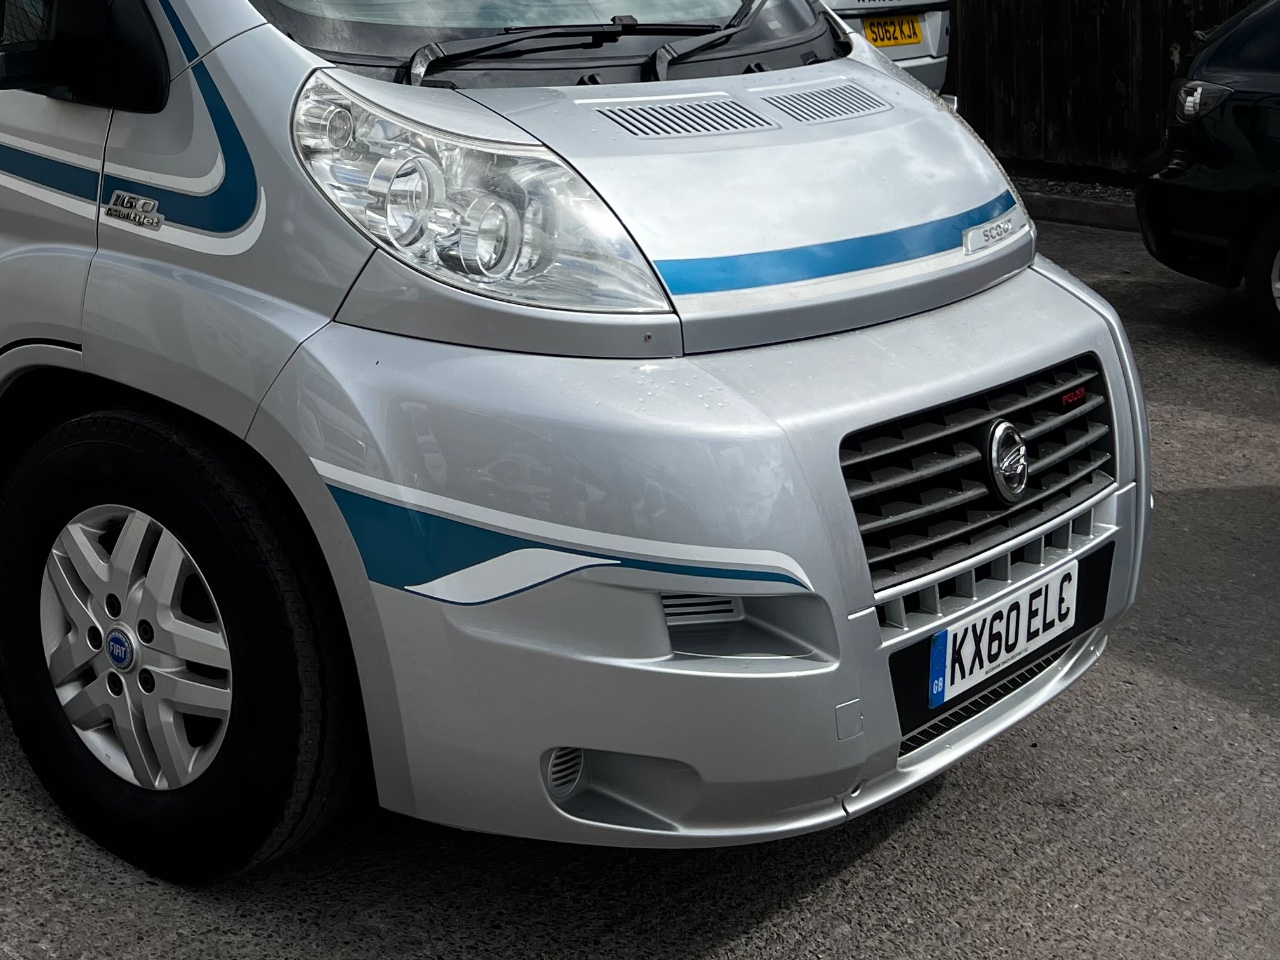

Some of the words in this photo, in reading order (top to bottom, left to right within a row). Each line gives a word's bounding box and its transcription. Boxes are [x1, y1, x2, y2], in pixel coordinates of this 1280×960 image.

[898, 18, 919, 40] KJA
[982, 218, 1013, 243] SCOUT
[950, 600, 1021, 687] KX60
[1026, 571, 1073, 644] ELC
[109, 641, 127, 659] FIAT
[932, 676, 945, 695] GB
